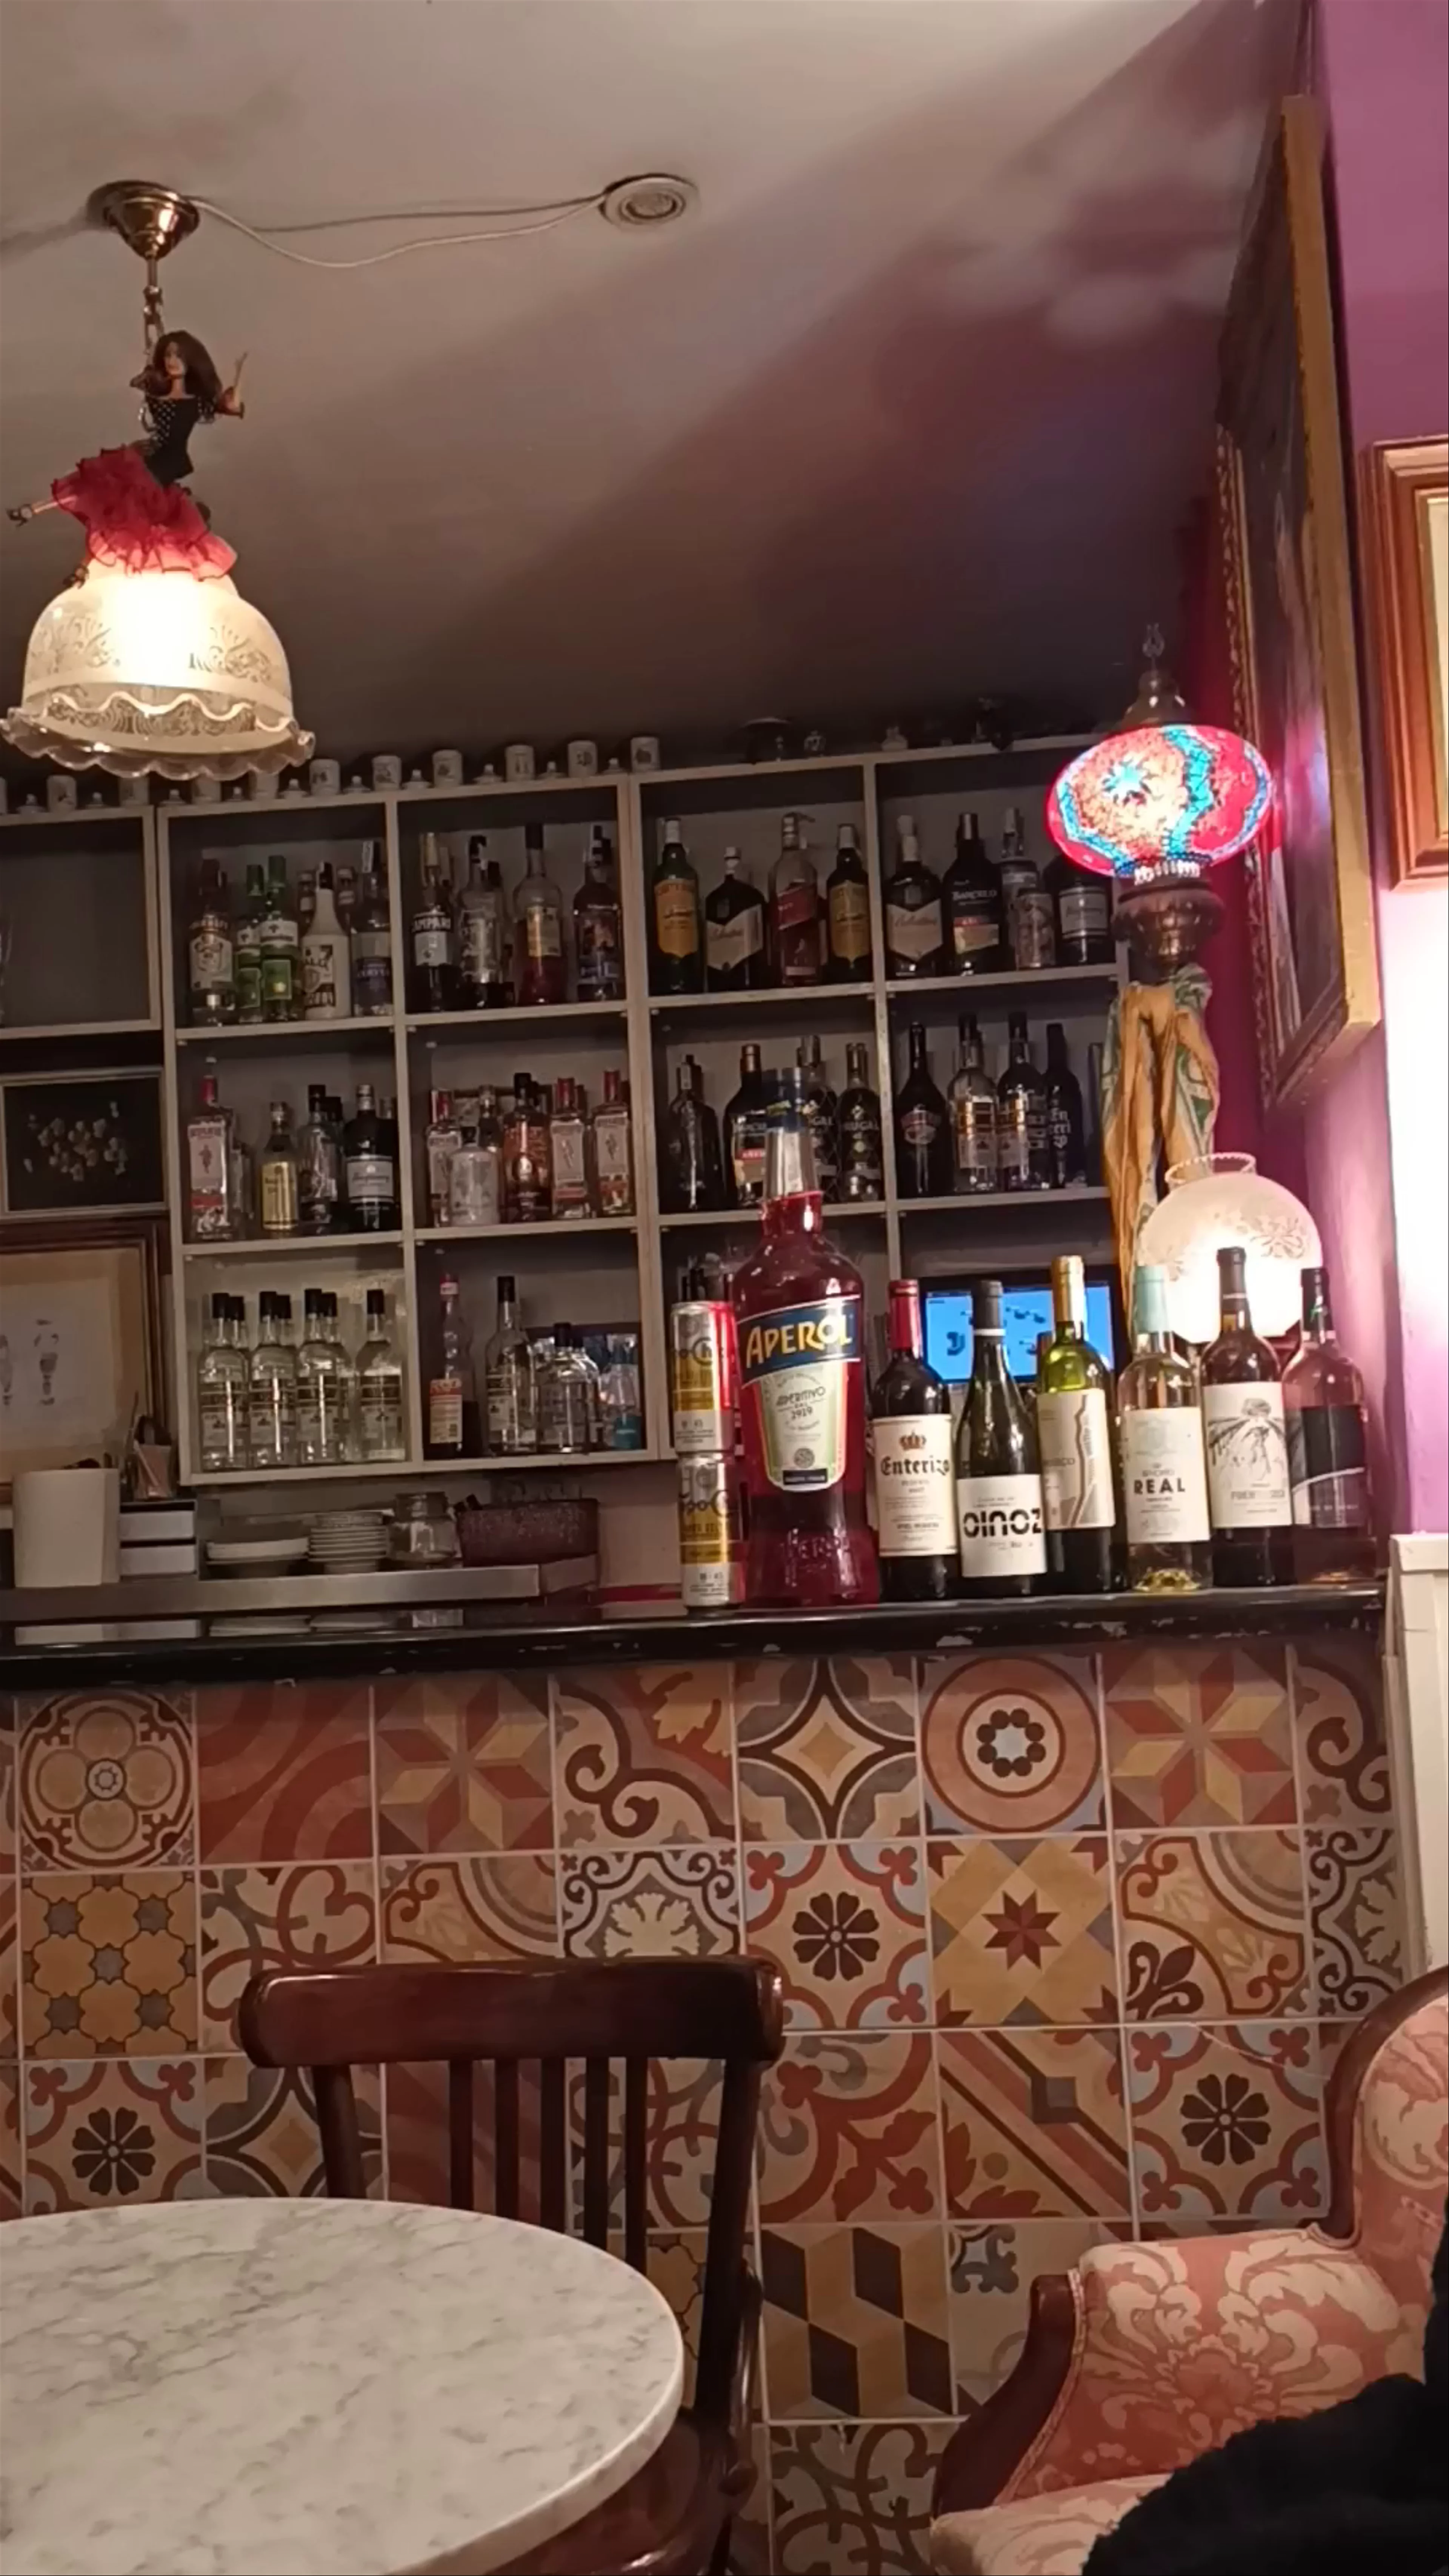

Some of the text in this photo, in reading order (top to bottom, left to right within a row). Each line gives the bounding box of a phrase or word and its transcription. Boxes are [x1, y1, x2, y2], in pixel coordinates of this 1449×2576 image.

[746, 1314, 853, 1369] APEROL
[880, 1455, 950, 1476] Enterizo
[1134, 1478, 1186, 1494] REAL
